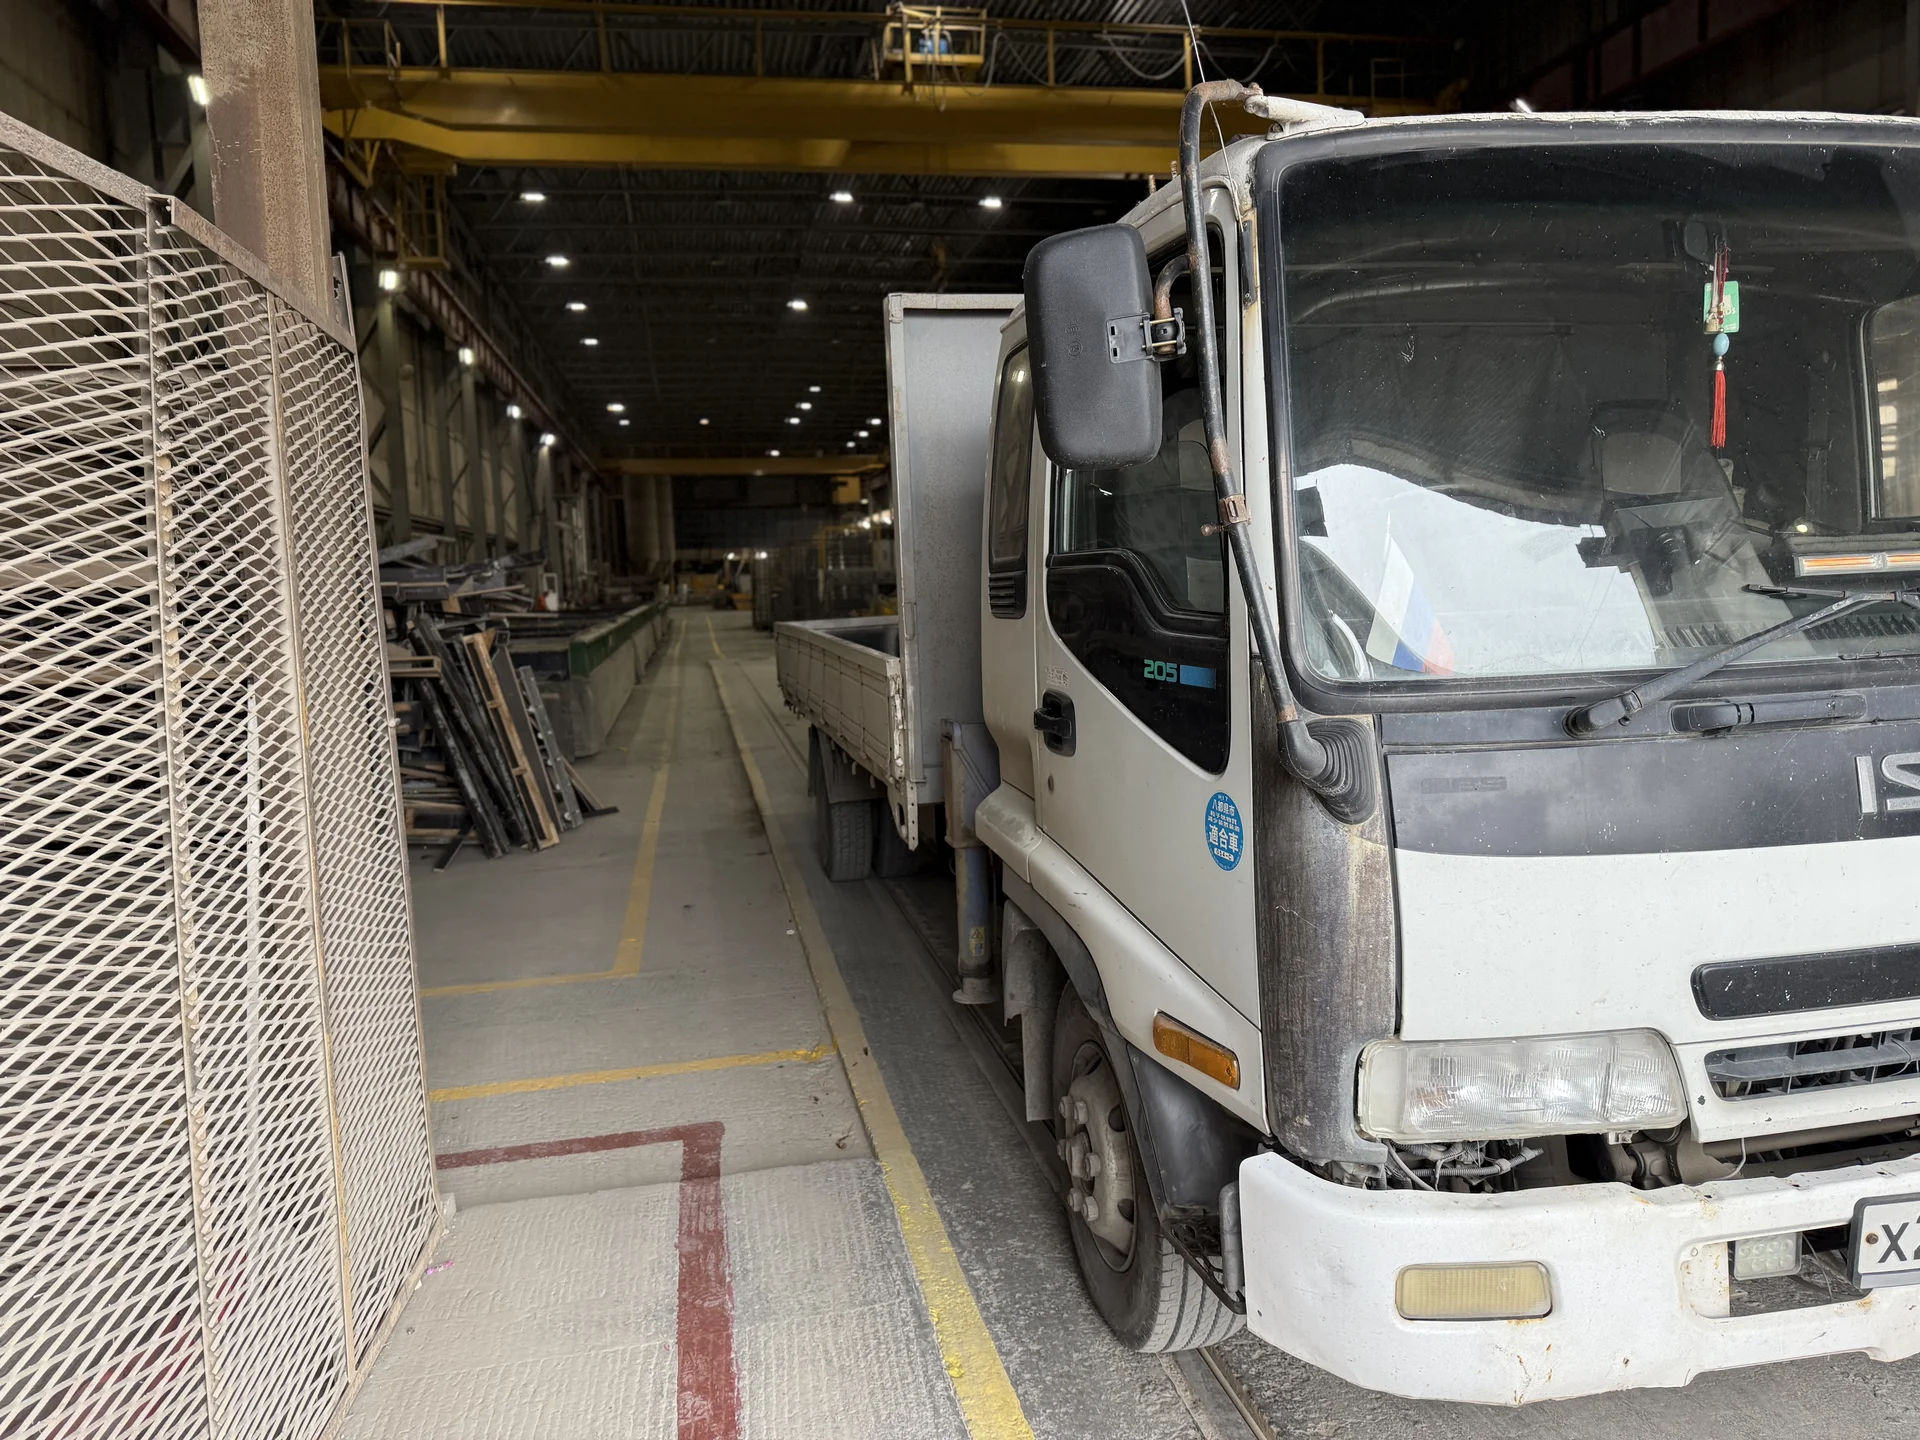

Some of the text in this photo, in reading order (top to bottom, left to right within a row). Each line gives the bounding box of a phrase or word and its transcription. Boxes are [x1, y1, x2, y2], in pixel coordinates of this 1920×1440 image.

[1143, 659, 1178, 683] 205
[1209, 824, 1239, 853] 適合車
[1877, 1216, 1920, 1263] X
